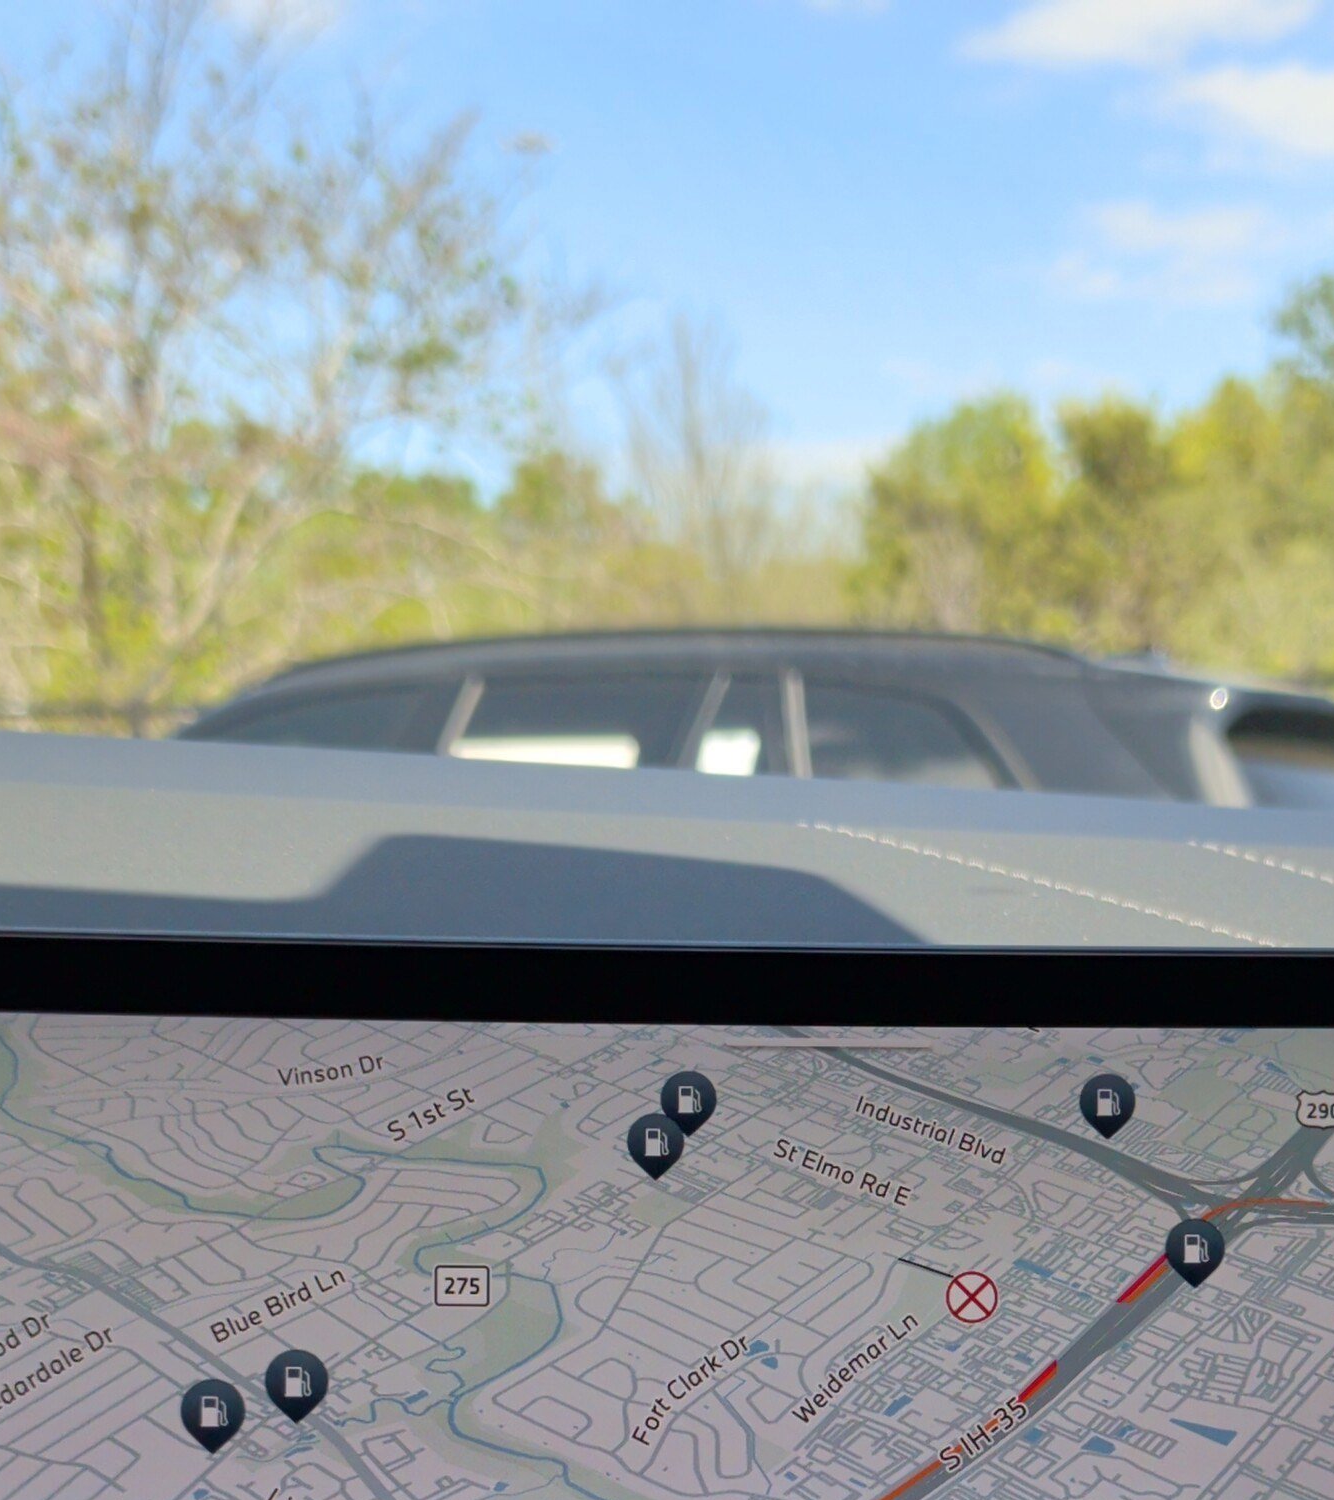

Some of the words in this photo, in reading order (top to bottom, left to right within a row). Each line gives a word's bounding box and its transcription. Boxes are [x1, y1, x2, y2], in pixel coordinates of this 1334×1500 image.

[277, 1061, 347, 1088] Vinson
[352, 1055, 385, 1075] Dr
[386, 1120, 406, 1143] S
[409, 1104, 446, 1132] 1st
[447, 1087, 475, 1111] St
[855, 1096, 954, 1150] Industrial
[956, 1132, 1006, 1166] Blvd
[773, 1138, 802, 1166] St
[803, 1152, 856, 1186] Elmo
[860, 1173, 892, 1201] Rd
[894, 1186, 913, 1207] E
[209, 1304, 259, 1344] Blue
[264, 1283, 314, 1320] Bird
[316, 1267, 347, 1293] Ln
[444, 1276, 481, 1296] 275
[25, 1310, 52, 1339] Dr
[87, 1323, 116, 1353] Dr
[632, 1392, 667, 1446] Fort
[666, 1351, 723, 1404] Clark
[719, 1332, 750, 1364] Dr
[791, 1335, 890, 1427] Weidemar
[888, 1312, 920, 1345] Ln
[938, 1444, 962, 1473] S
[963, 1398, 1029, 1456] IH-35
